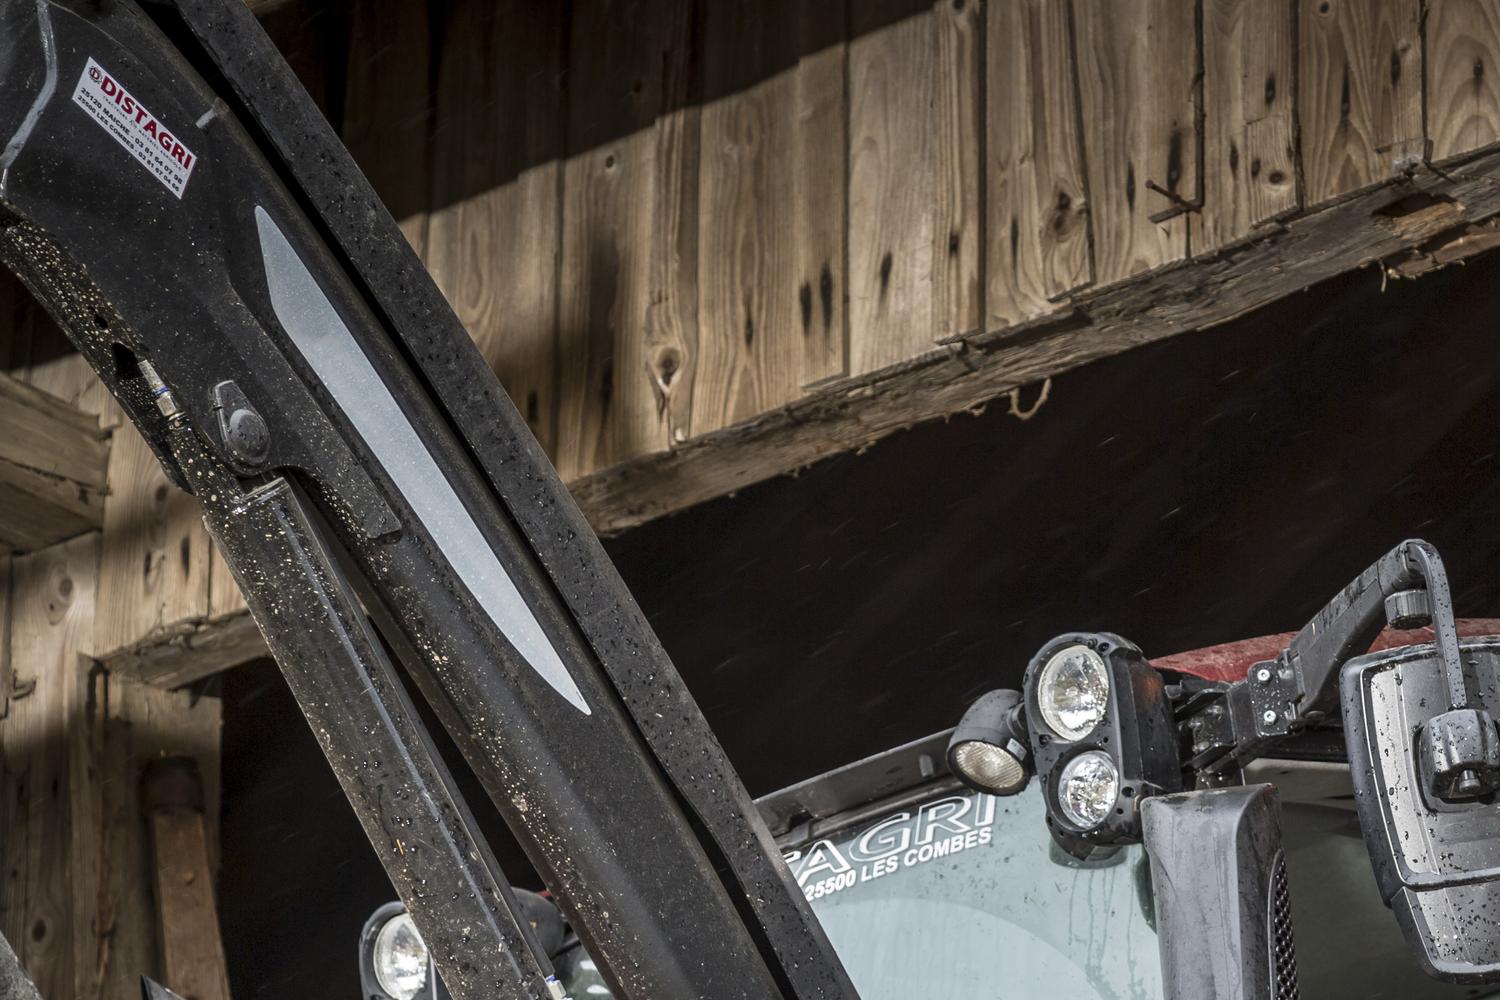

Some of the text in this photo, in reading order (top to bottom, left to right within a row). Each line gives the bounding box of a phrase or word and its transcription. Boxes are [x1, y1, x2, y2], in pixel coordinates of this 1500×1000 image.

[96, 112, 108, 125] LES
[109, 123, 134, 149] COMBES
[99, 74, 192, 170] DISTAGRI
[102, 107, 129, 135] MAICHE
[805, 827, 992, 901] 25500 LES COMBES
